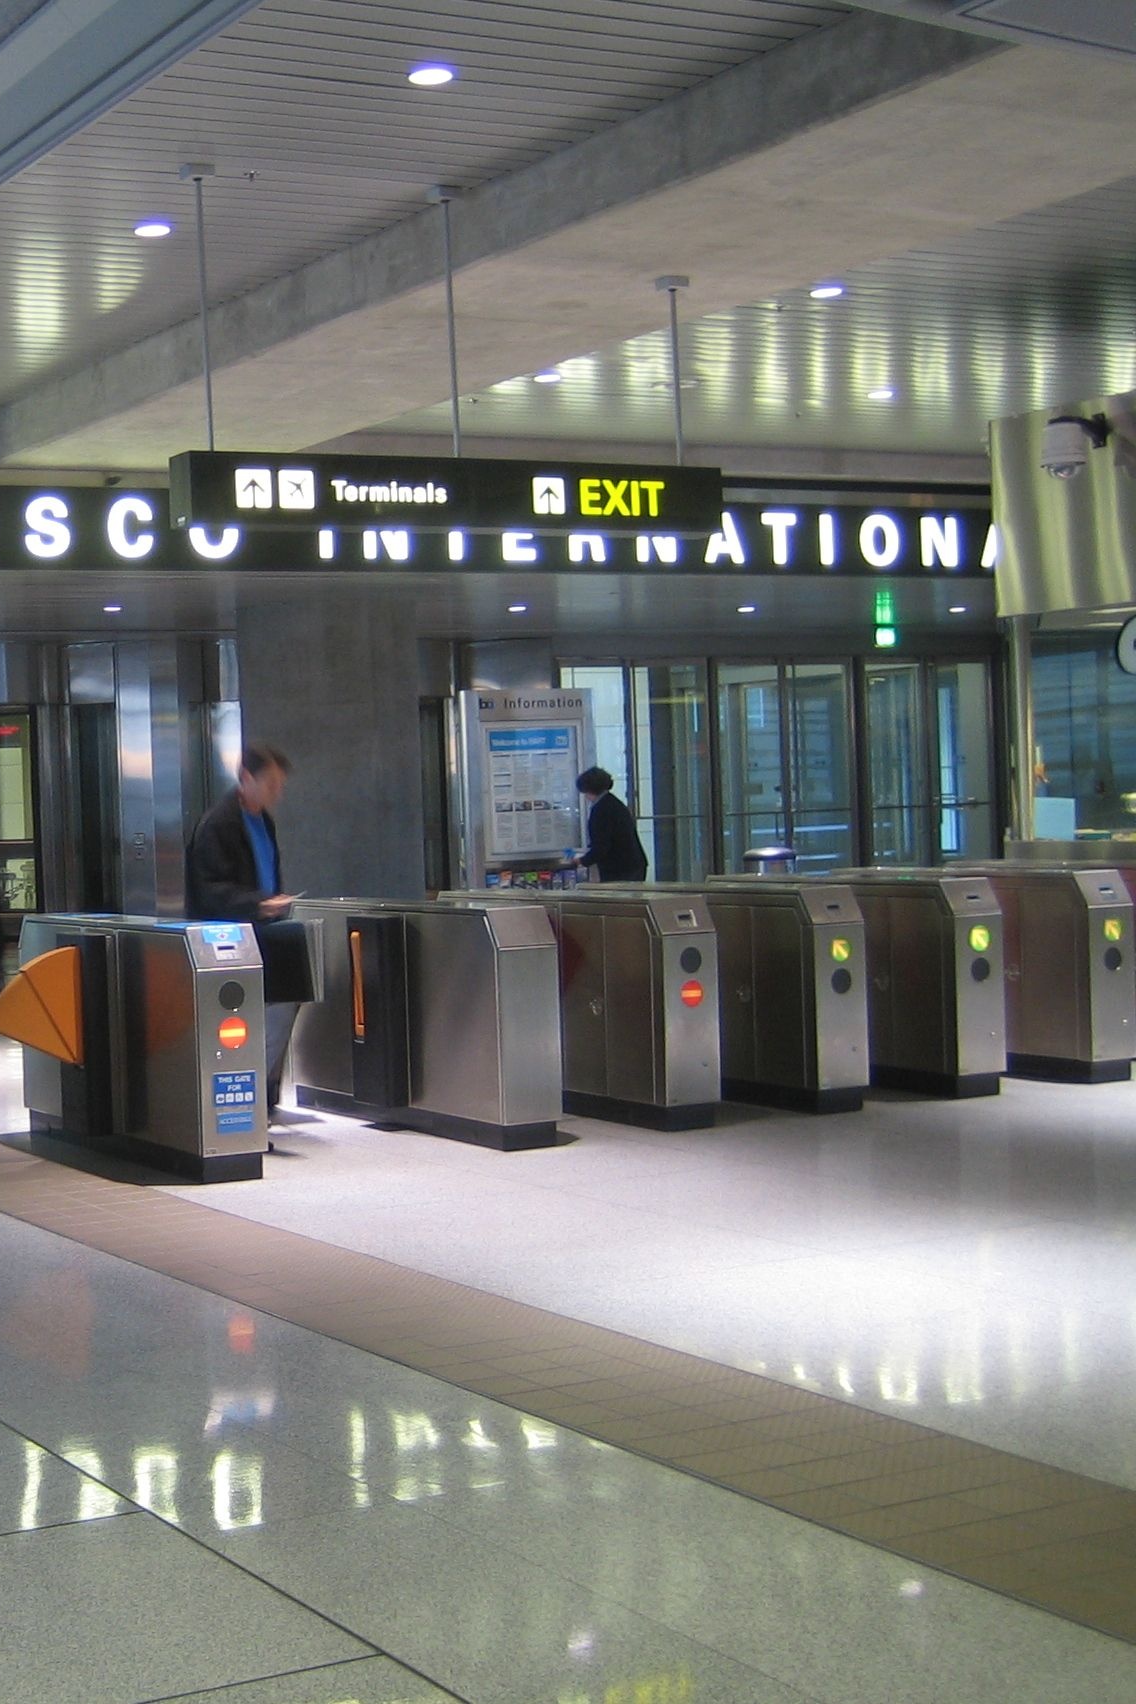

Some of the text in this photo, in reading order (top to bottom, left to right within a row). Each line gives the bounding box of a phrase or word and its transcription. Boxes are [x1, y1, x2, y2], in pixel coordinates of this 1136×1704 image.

[331, 478, 448, 505] Terminals
[579, 477, 665, 517] EXIT
[504, 697, 583, 709] Information
